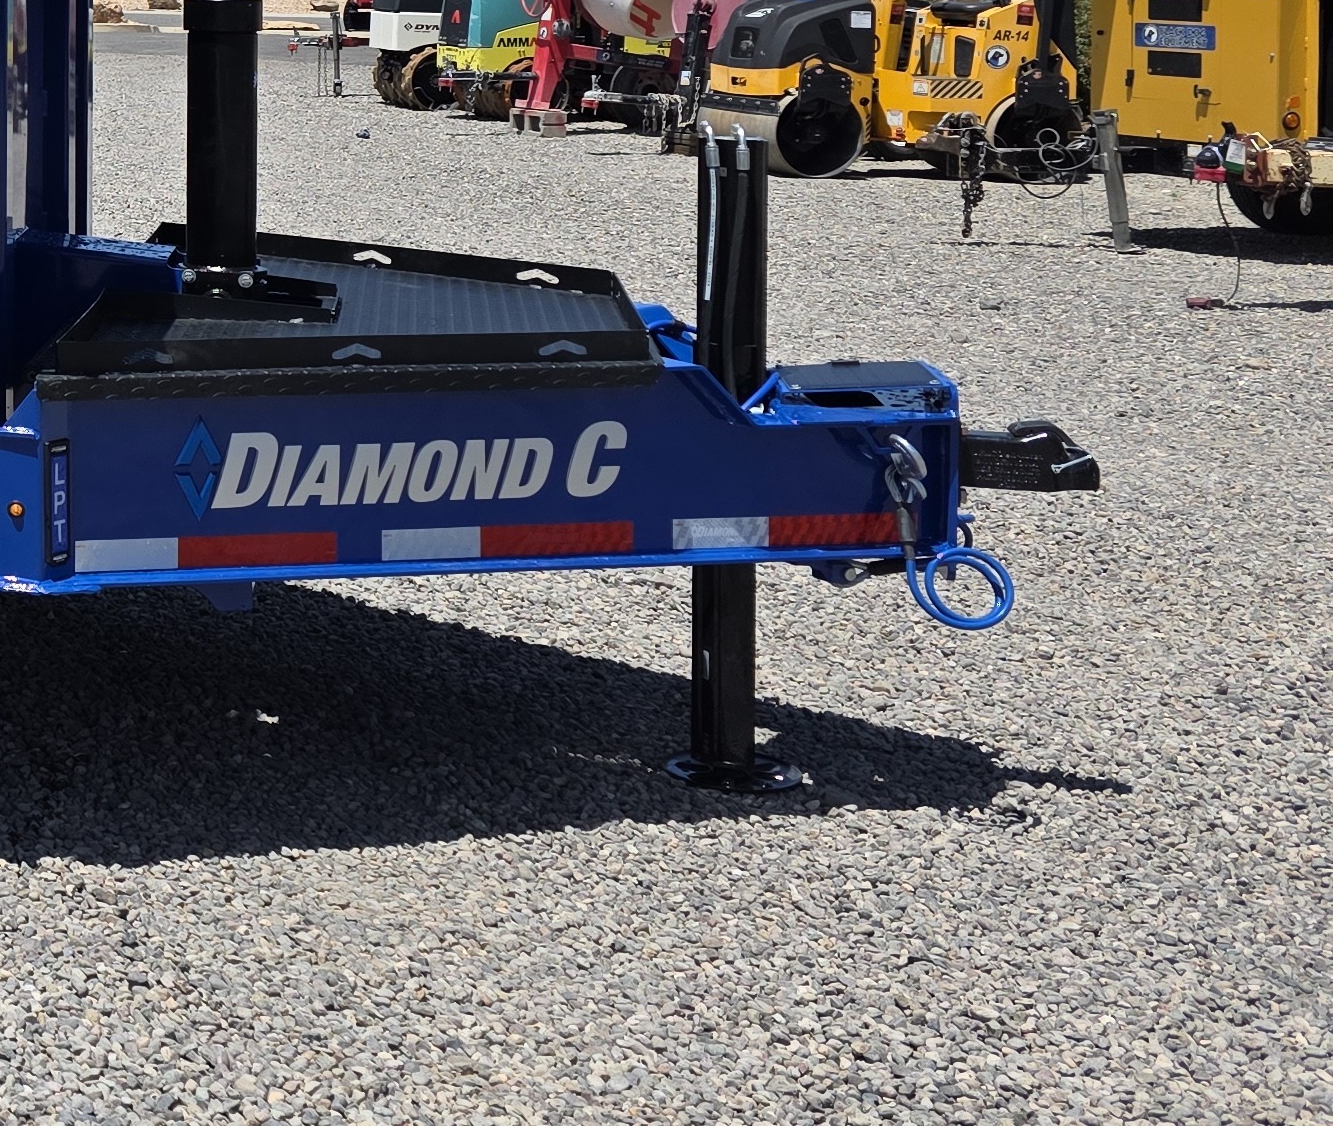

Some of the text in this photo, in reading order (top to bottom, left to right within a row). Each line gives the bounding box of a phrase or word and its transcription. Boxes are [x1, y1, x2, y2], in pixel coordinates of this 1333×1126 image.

[414, 23, 440, 31] DYN
[993, 30, 1030, 42] AR-14
[210, 420, 628, 510] DIAMOND C
[53, 462, 67, 544] LPT
